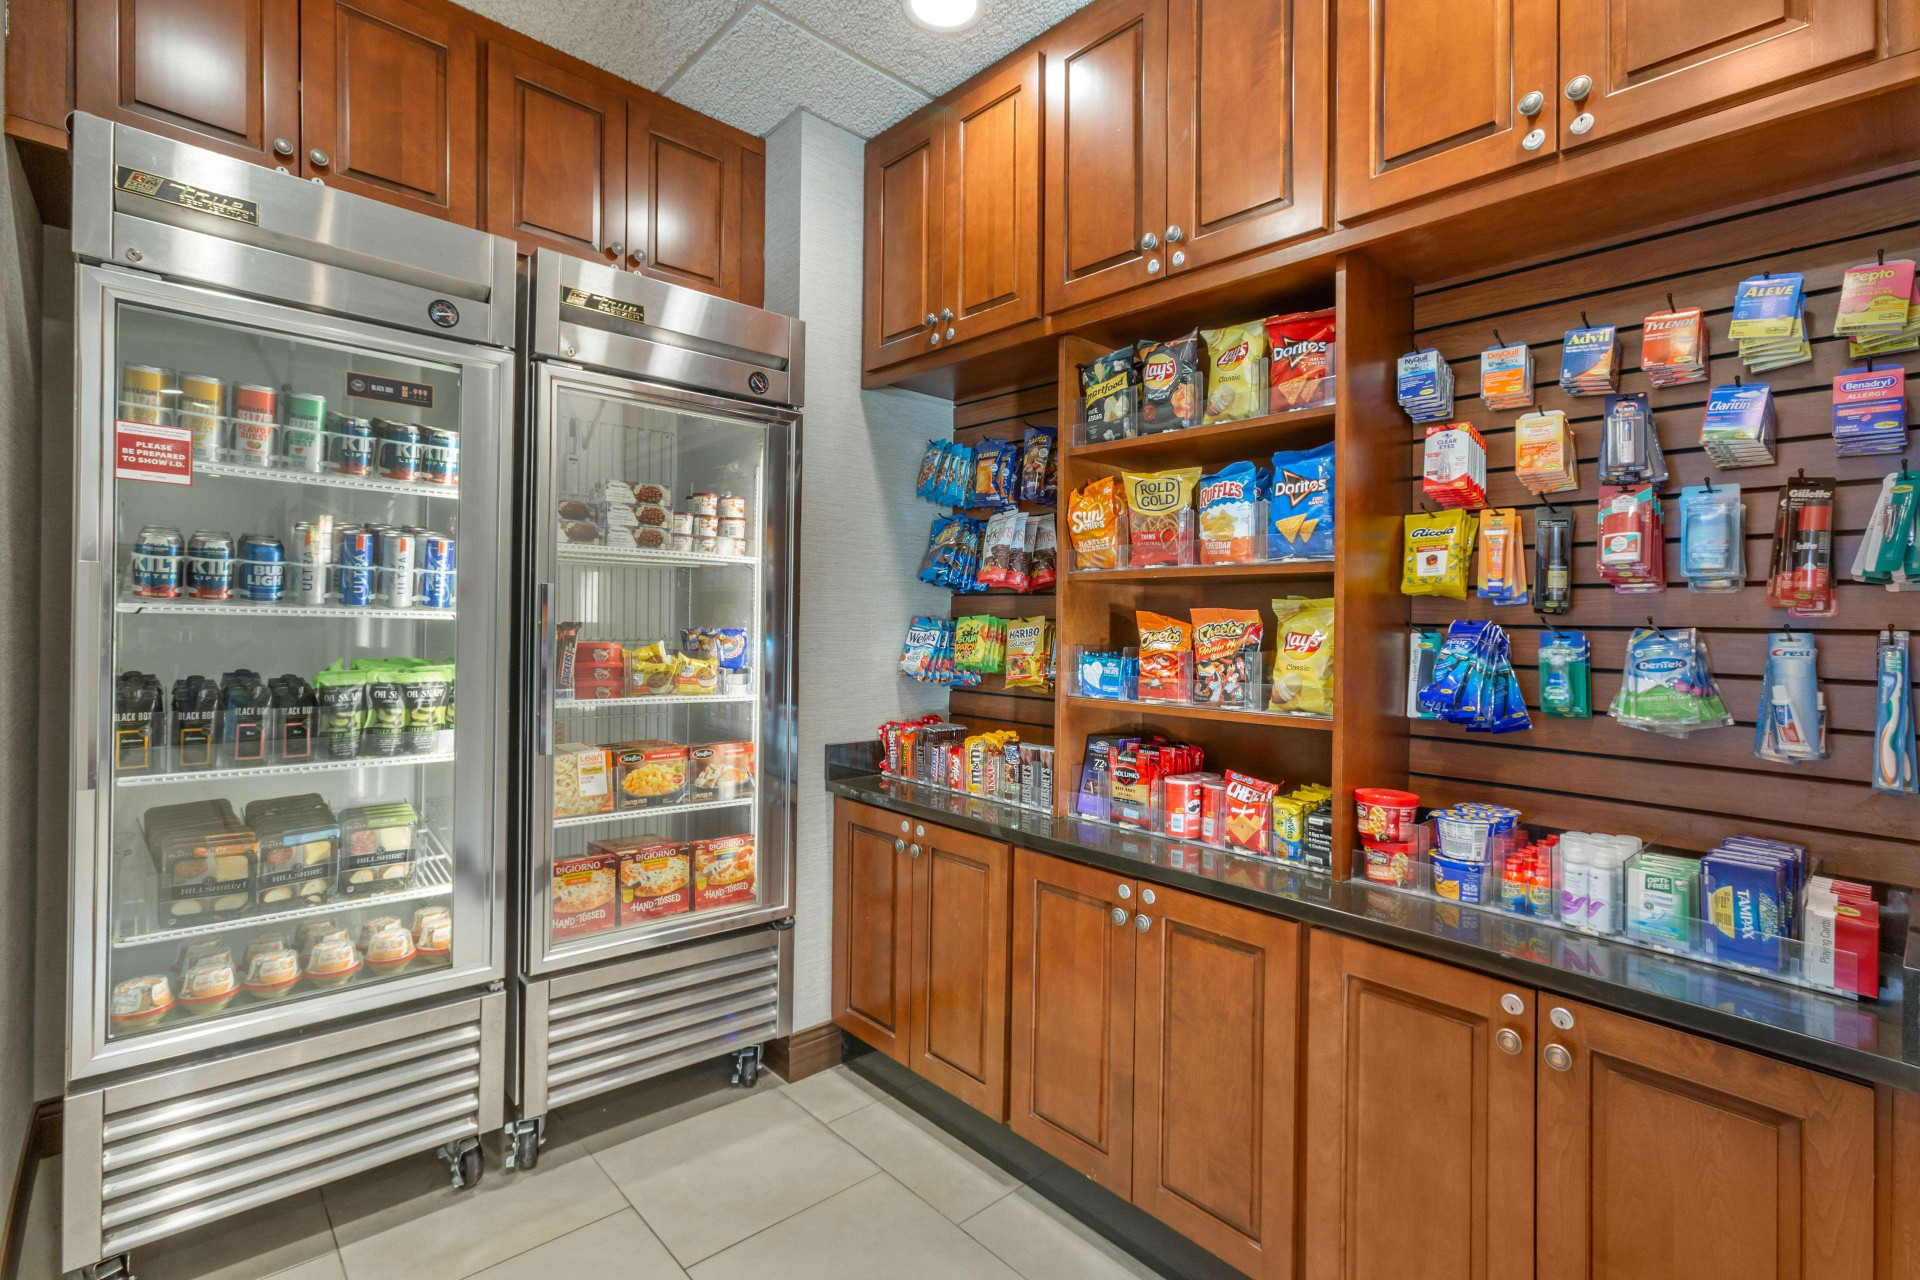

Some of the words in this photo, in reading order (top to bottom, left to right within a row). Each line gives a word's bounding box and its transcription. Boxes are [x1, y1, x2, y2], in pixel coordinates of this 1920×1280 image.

[1849, 269, 1896, 282] Pepto
[1646, 318, 1696, 332] TYLENOL
[1567, 331, 1610, 345] Advil
[1217, 342, 1249, 367] Lay's
[1274, 340, 1327, 363] Doritos
[1487, 348, 1519, 360] DayQuil
[1404, 354, 1428, 365] NyQuil
[1144, 363, 1175, 381] Lay's
[1218, 373, 1241, 384] Classic
[1846, 378, 1891, 390] Benadryl
[1847, 391, 1887, 400] ALLERGY
[1709, 399, 1750, 413] Claritin
[136, 441, 173, 452] PLEASE
[1436, 438, 1457, 446] CLEAR
[122, 447, 135, 455] BE
[136, 449, 186, 461] PREPARED
[122, 455, 136, 463] TO
[138, 456, 168, 466] SHOW
[169, 460, 186, 469] I.D.
[1140, 481, 1176, 494] ROLD
[1275, 477, 1328, 497] Doritos
[1788, 489, 1832, 499] Gillette
[1140, 493, 1176, 507] GOLD
[1200, 481, 1244, 508] RUFFLES
[1072, 505, 1103, 534] Sun
[1082, 519, 1106, 530] CHIPS
[1411, 527, 1456, 539] Ricola
[1205, 541, 1232, 550] CHEDDAR
[134, 557, 179, 573] KILT
[253, 565, 283, 577] BUD
[302, 551, 313, 592] ULTRA
[353, 554, 367, 594] ULTRA
[397, 556, 408, 595] ULTRA
[908, 631, 936, 645] Welch's
[957, 634, 978, 644] SOUR
[1009, 627, 1040, 641] HARIBO
[1140, 626, 1182, 648] Cheetos
[1199, 620, 1246, 644] Cheetos
[955, 642, 977, 651] PATCH
[1009, 639, 1037, 648] Goldbears
[1284, 632, 1323, 652] Lay's
[1771, 648, 1811, 657] Crest
[561, 653, 574, 686] SNICKERS
[1285, 663, 1311, 672] Classic
[1639, 660, 1684, 670] DenTek
[373, 690, 386, 699] OH
[406, 690, 419, 699] OH
[114, 712, 136, 722] BLACK
[138, 711, 153, 721] BOX
[178, 711, 200, 721] BLACK
[201, 711, 215, 720] BOX
[234, 707, 255, 716] BLACK
[888, 730, 898, 770] Skittles
[580, 753, 603, 763] Lean
[1021, 764, 1032, 804] HERSHEY'S
[1041, 767, 1051, 808] HERSHEY'S
[708, 839, 745, 852] DIGIORNO
[357, 852, 405, 865] HILLSHIRE
[635, 848, 676, 861] DIGIORNO
[272, 868, 323, 883] HILLSHIRE
[556, 861, 601, 876] DIGIORNO
[1646, 877, 1670, 885] OPTI-
[703, 882, 749, 899] HAND-TOSSED
[630, 893, 681, 912] HAND-TOSSED
[1736, 889, 1755, 940] TAMPAX
[1820, 918, 1832, 938] Cards
[1820, 938, 1834, 965] Playing
